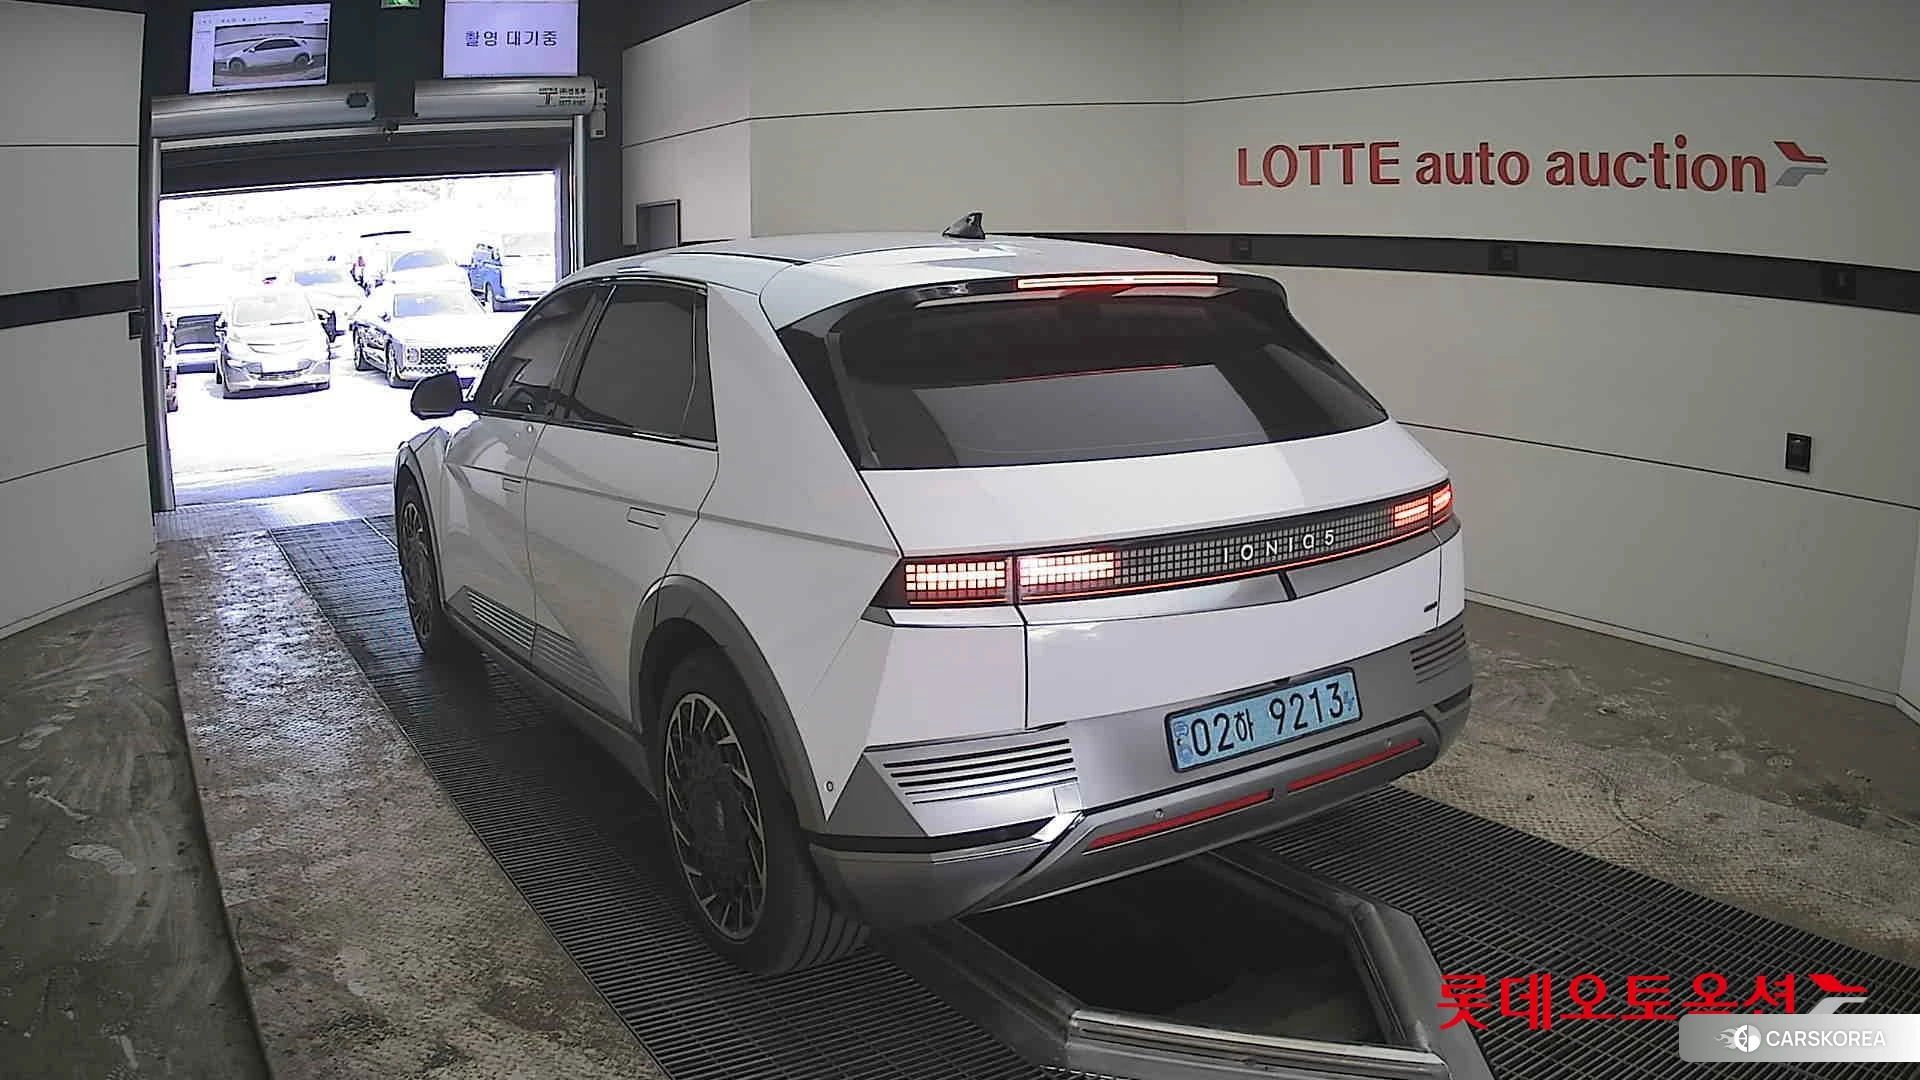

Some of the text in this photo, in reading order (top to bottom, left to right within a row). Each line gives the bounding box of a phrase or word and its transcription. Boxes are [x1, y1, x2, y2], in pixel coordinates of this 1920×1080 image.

[506, 31, 557, 47] 대기중
[1237, 134, 1768, 193] LOTTE auto auction
[1190, 681, 1344, 757] 02하 9213
